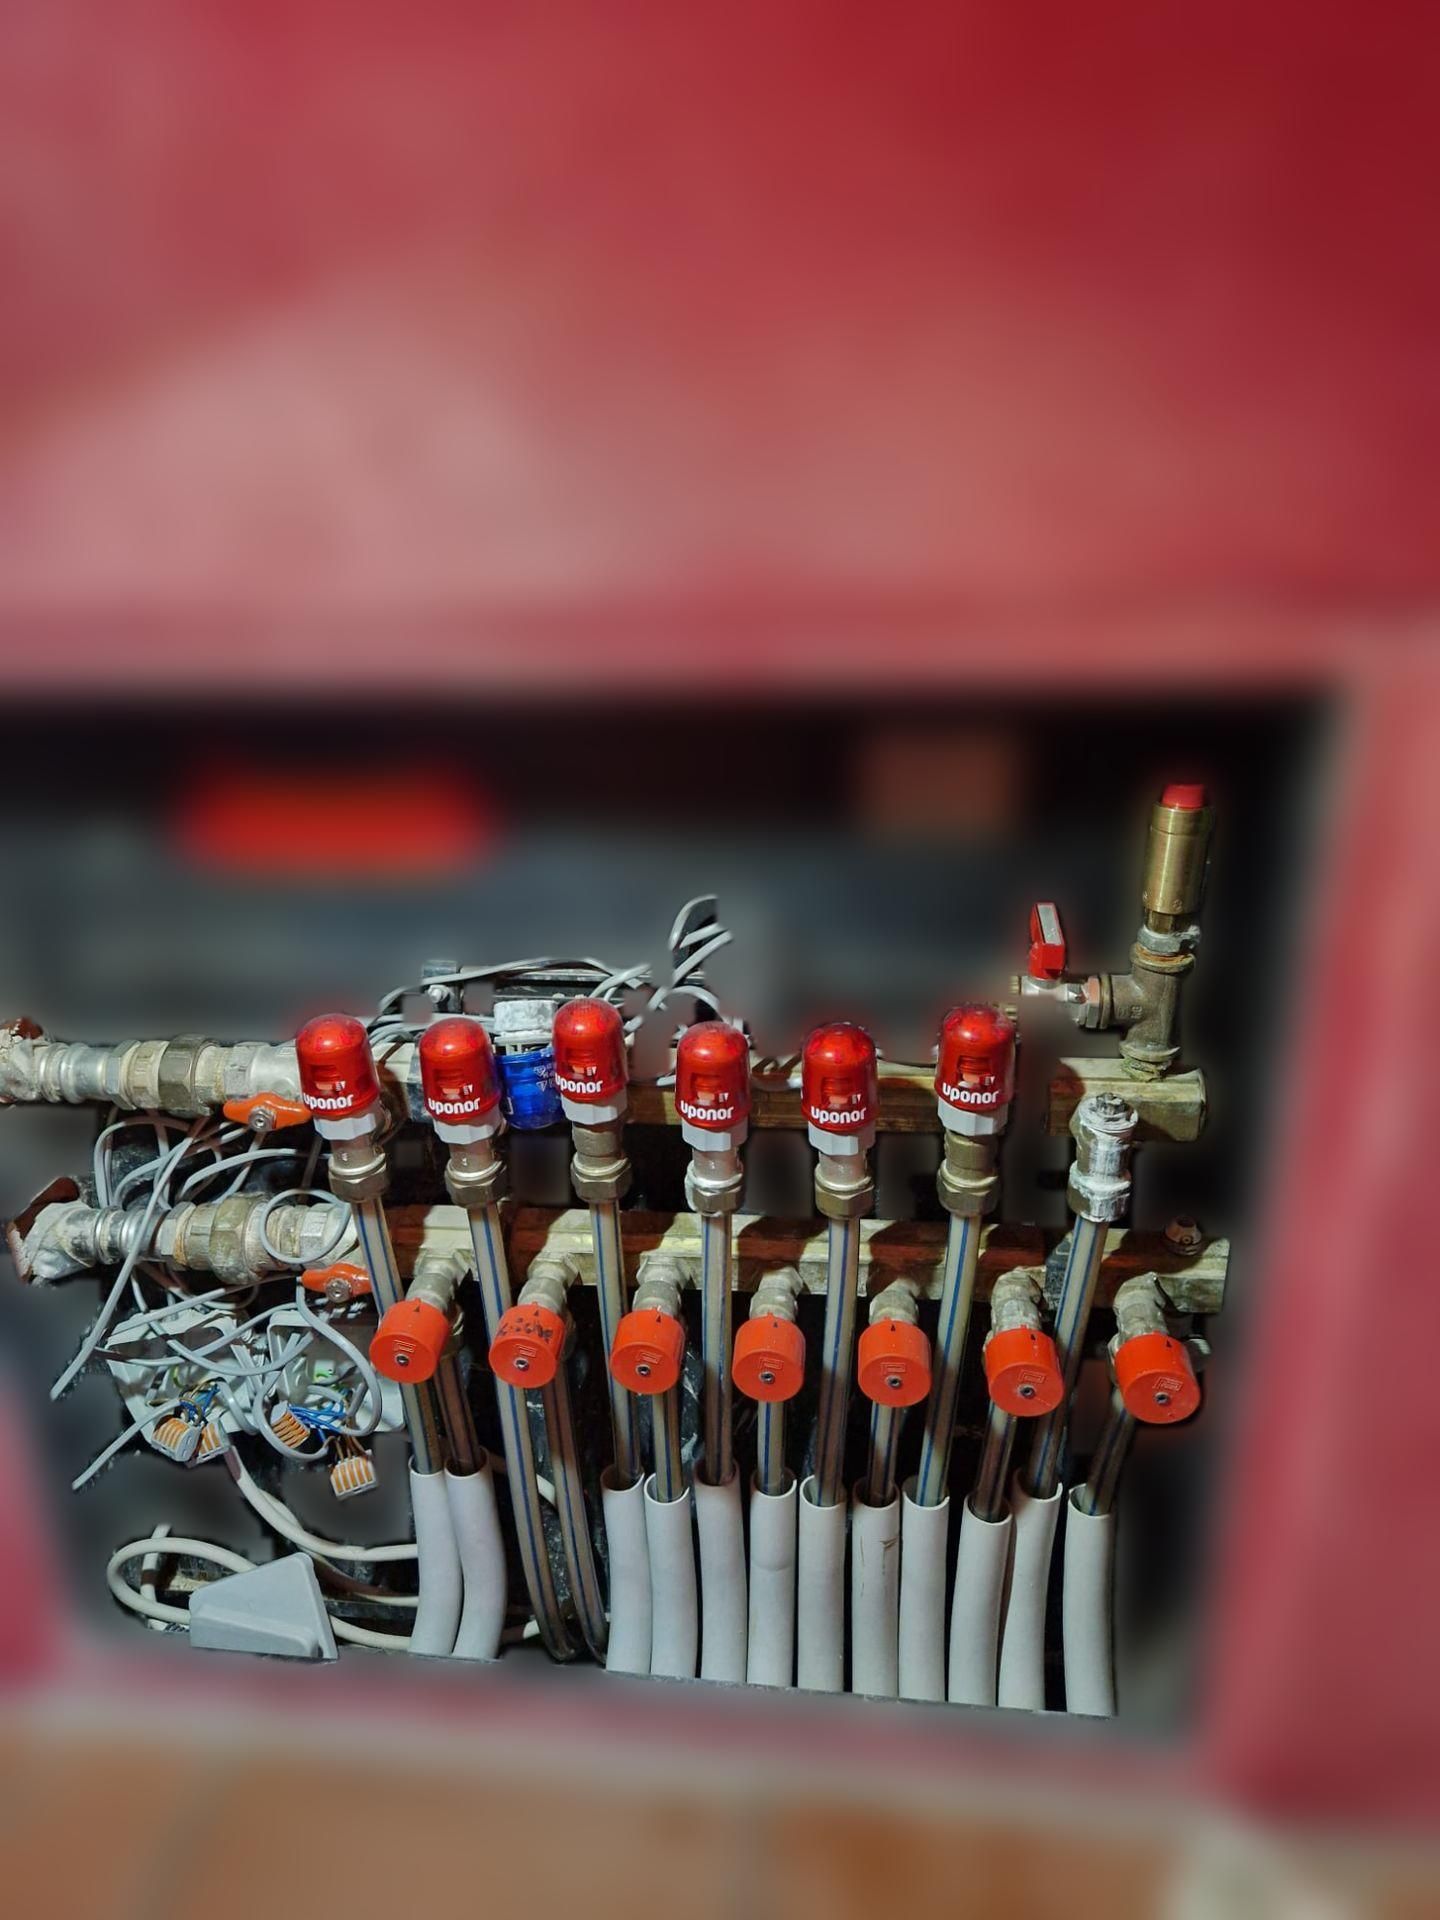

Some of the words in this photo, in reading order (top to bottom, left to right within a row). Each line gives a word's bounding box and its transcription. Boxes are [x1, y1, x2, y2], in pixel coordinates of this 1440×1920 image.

[554, 1072, 603, 1094] uponor
[942, 1081, 999, 1105] uponor
[302, 1091, 354, 1111] uponor
[428, 1097, 481, 1116] uponor
[680, 1100, 734, 1122] uponor
[810, 1105, 867, 1126] uponor
